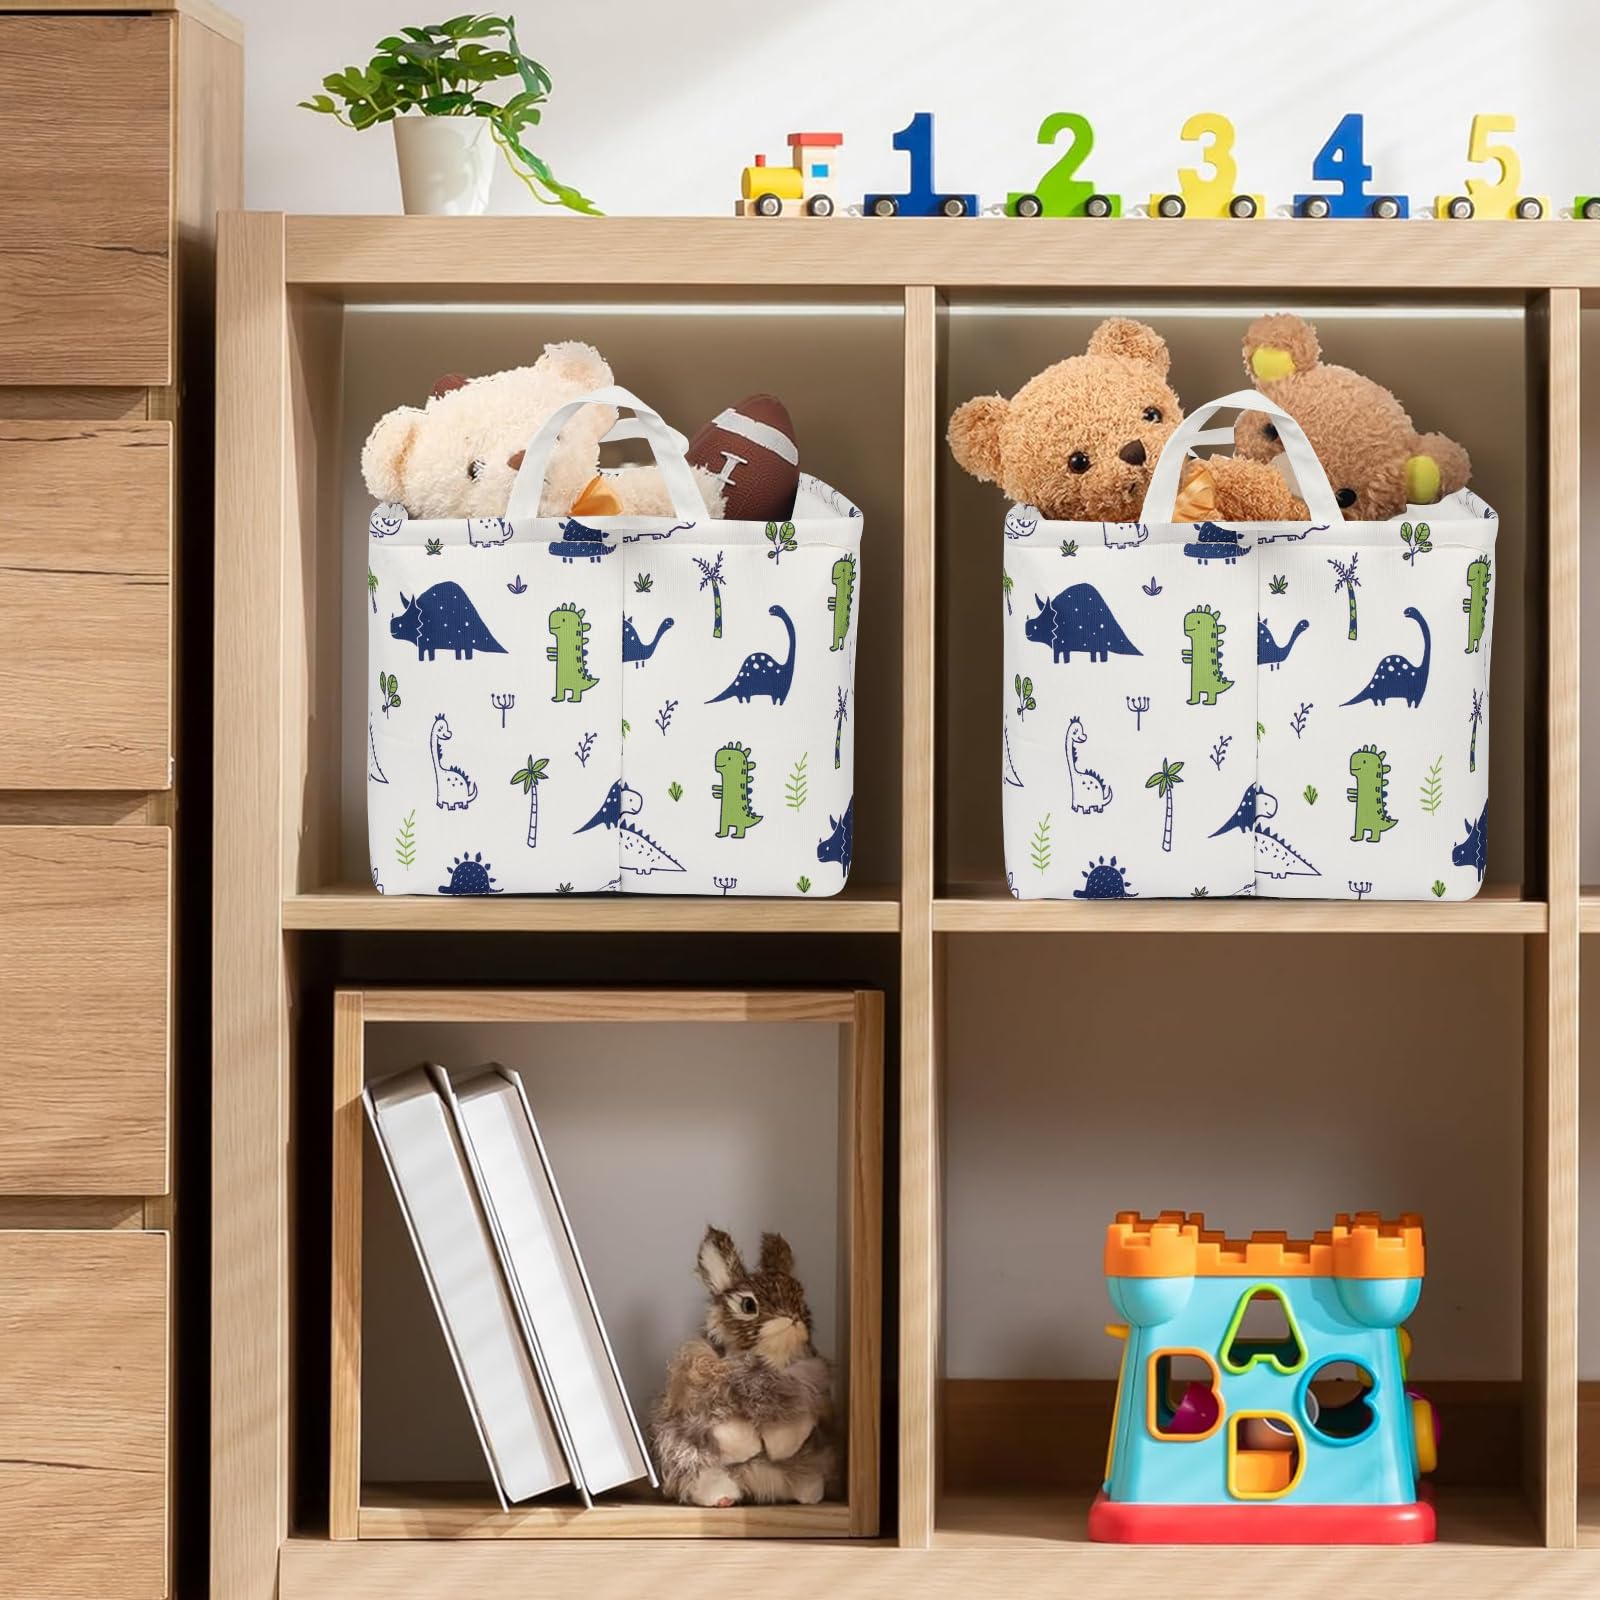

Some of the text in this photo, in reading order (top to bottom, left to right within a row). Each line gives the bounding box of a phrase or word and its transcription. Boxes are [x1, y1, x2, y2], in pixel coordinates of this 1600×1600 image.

[893, 111, 1522, 206] 1 2 3 4 5
